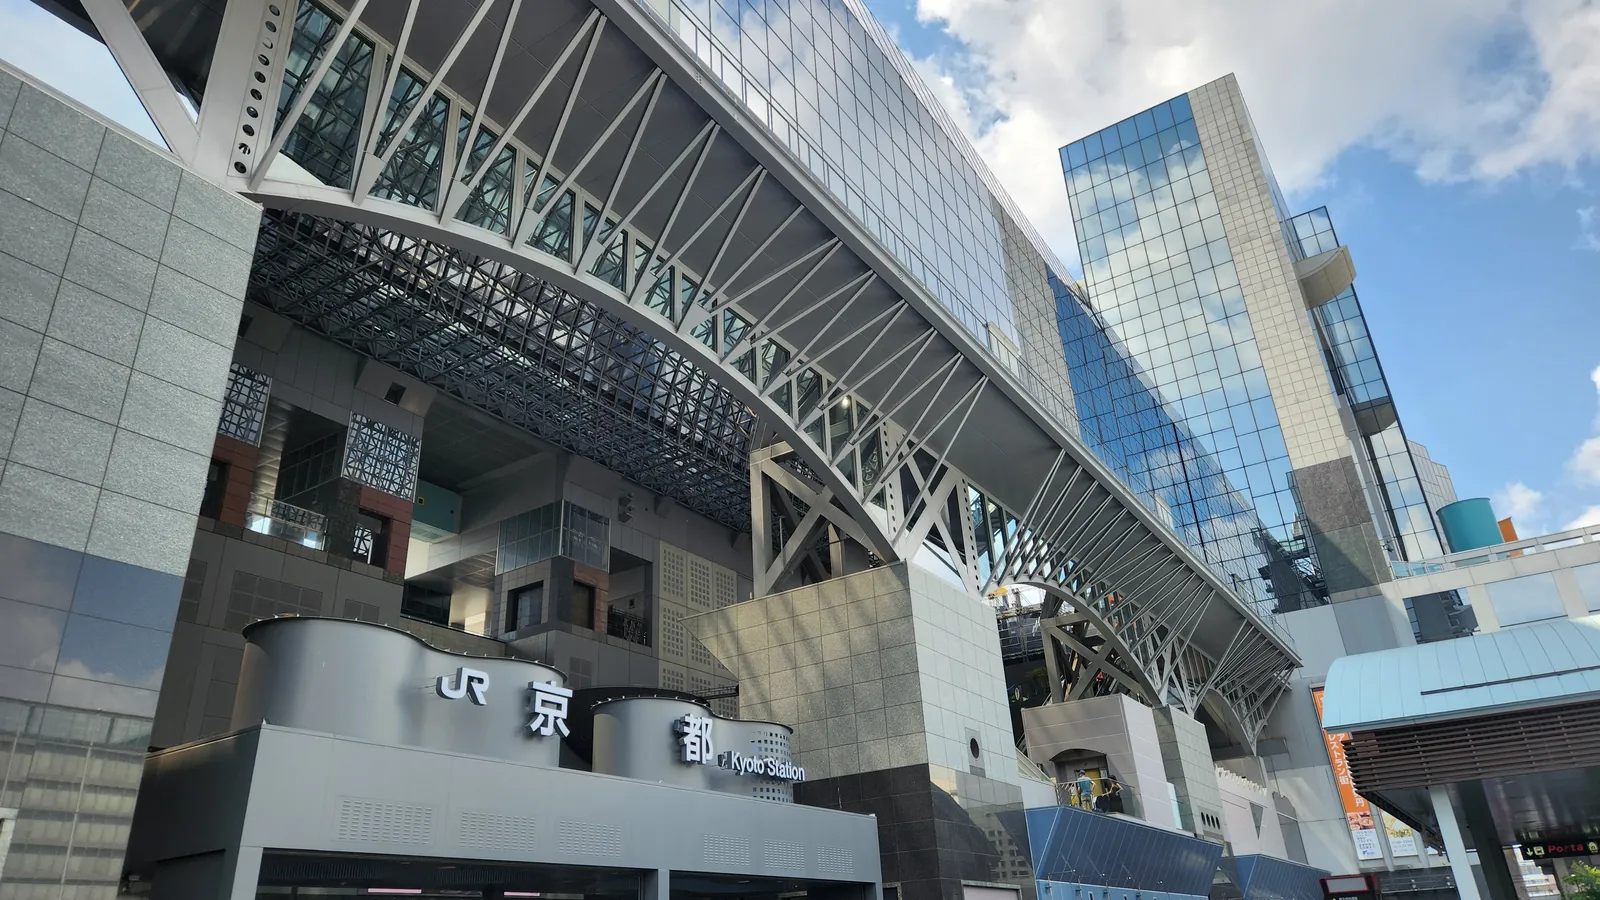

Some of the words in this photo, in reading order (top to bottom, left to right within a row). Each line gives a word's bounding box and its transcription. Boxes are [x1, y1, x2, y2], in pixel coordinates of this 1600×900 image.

[437, 667, 490, 706] JR
[529, 680, 574, 738] 京
[680, 713, 714, 765] 都
[731, 750, 765, 776] Kyoto
[767, 758, 805, 781] Station
[1328, 733, 1350, 785] レストラン街
[1547, 844, 1584, 853] Porta
